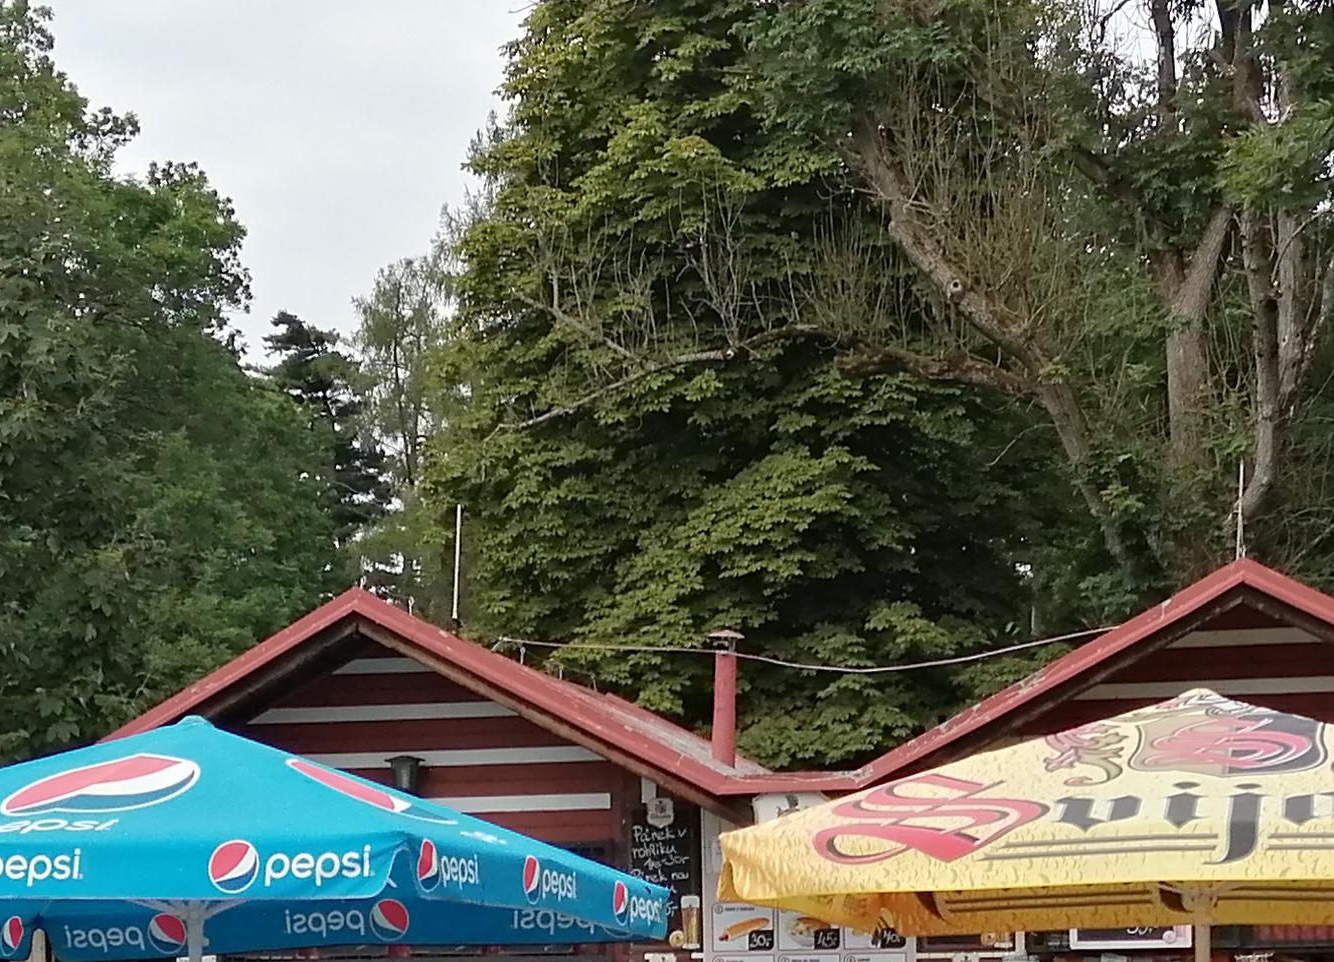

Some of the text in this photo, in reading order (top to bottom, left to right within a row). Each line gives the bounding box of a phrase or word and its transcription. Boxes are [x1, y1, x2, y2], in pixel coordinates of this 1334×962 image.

[264, 844, 376, 887] pepsi
[440, 854, 479, 890] pepsi
[542, 871, 578, 901] pepsi
